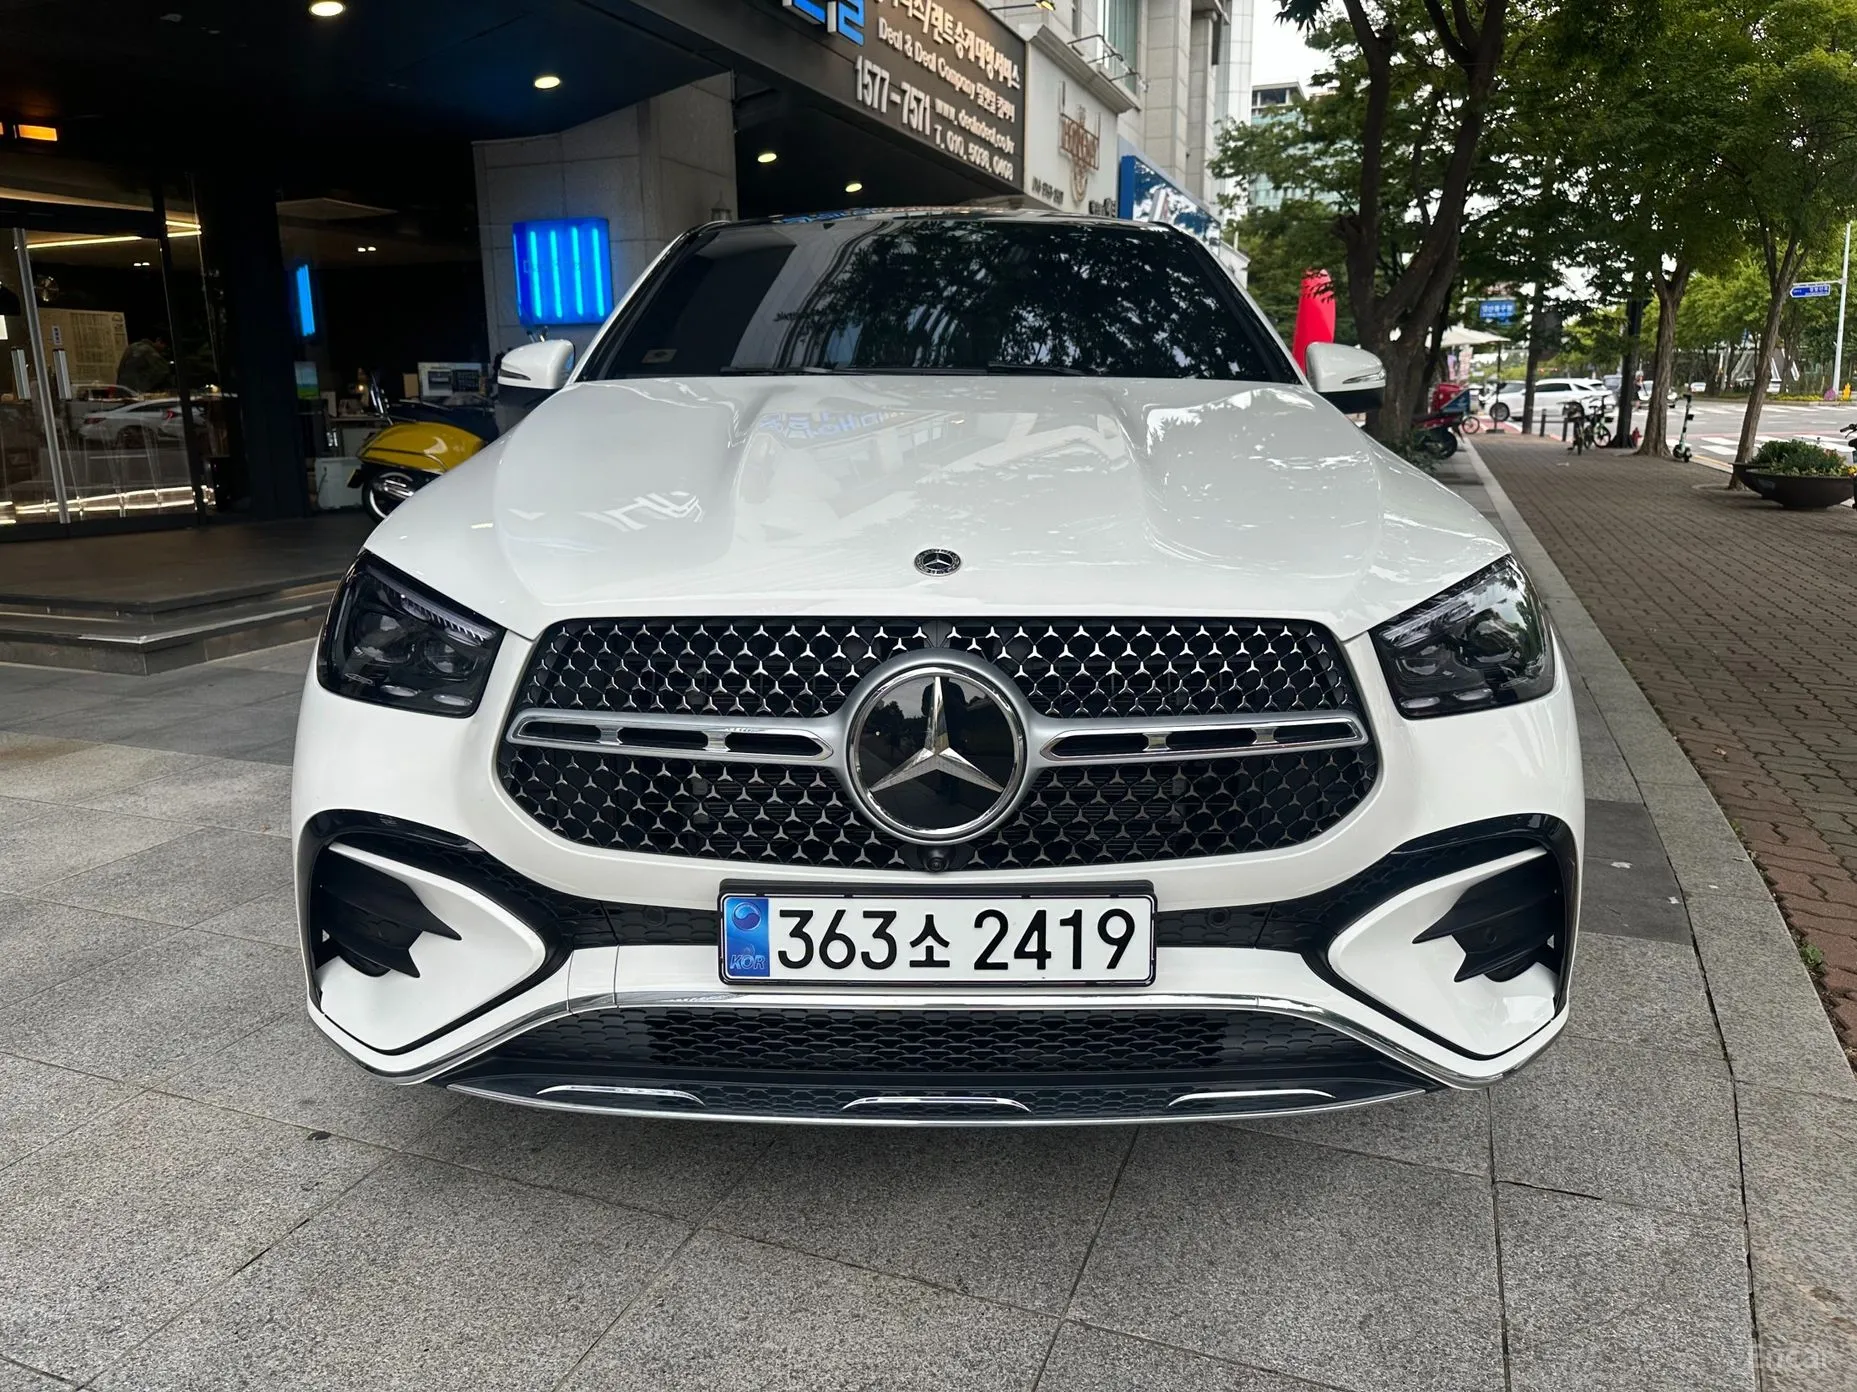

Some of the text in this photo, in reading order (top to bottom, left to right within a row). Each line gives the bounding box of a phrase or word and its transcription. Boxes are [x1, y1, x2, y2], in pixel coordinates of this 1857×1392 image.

[874, 0, 1020, 90] 스/렌트승계대행서비스
[878, 17, 903, 51] Deal
[904, 34, 913, 58] &
[914, 41, 937, 73] Deal
[937, 57, 976, 99] Company
[855, 55, 931, 136] 1577-7571
[729, 954, 766, 970] KOR
[777, 908, 1136, 971] 363소 2419
